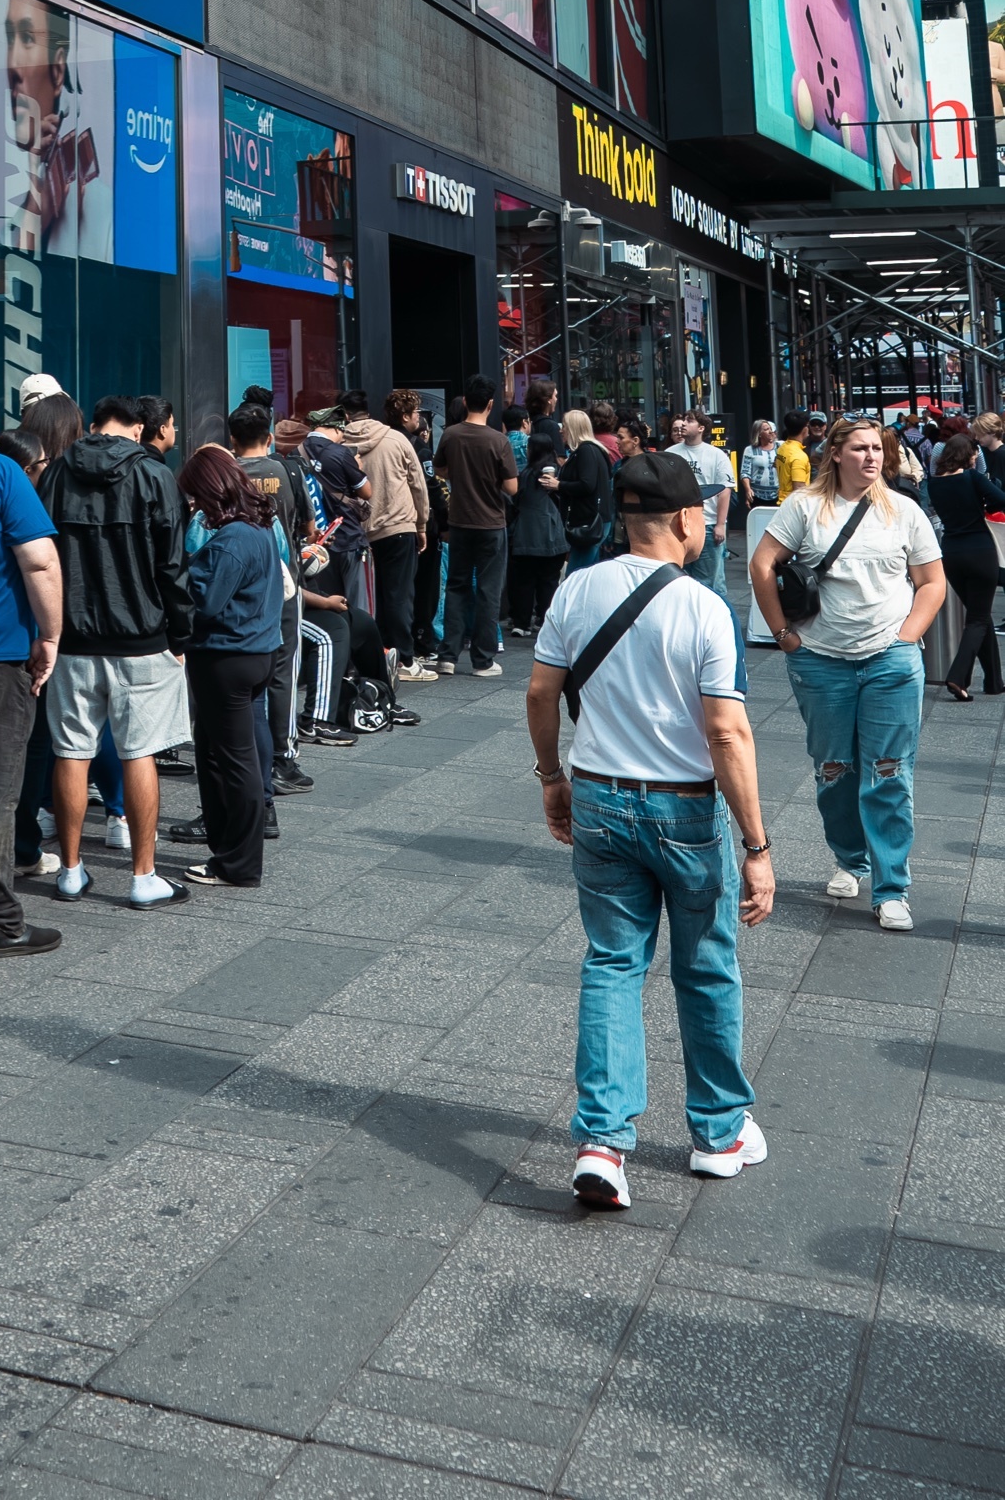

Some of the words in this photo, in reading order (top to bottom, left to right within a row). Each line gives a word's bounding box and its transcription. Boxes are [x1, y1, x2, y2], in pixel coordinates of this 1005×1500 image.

[572, 103, 623, 200] Think
[622, 135, 657, 208] bold
[425, 170, 476, 218] TISSOT
[671, 185, 696, 228] KPOP
[697, 199, 728, 245] SQUARE
[729, 218, 738, 251] BY
[263, 477, 280, 494] CUP
